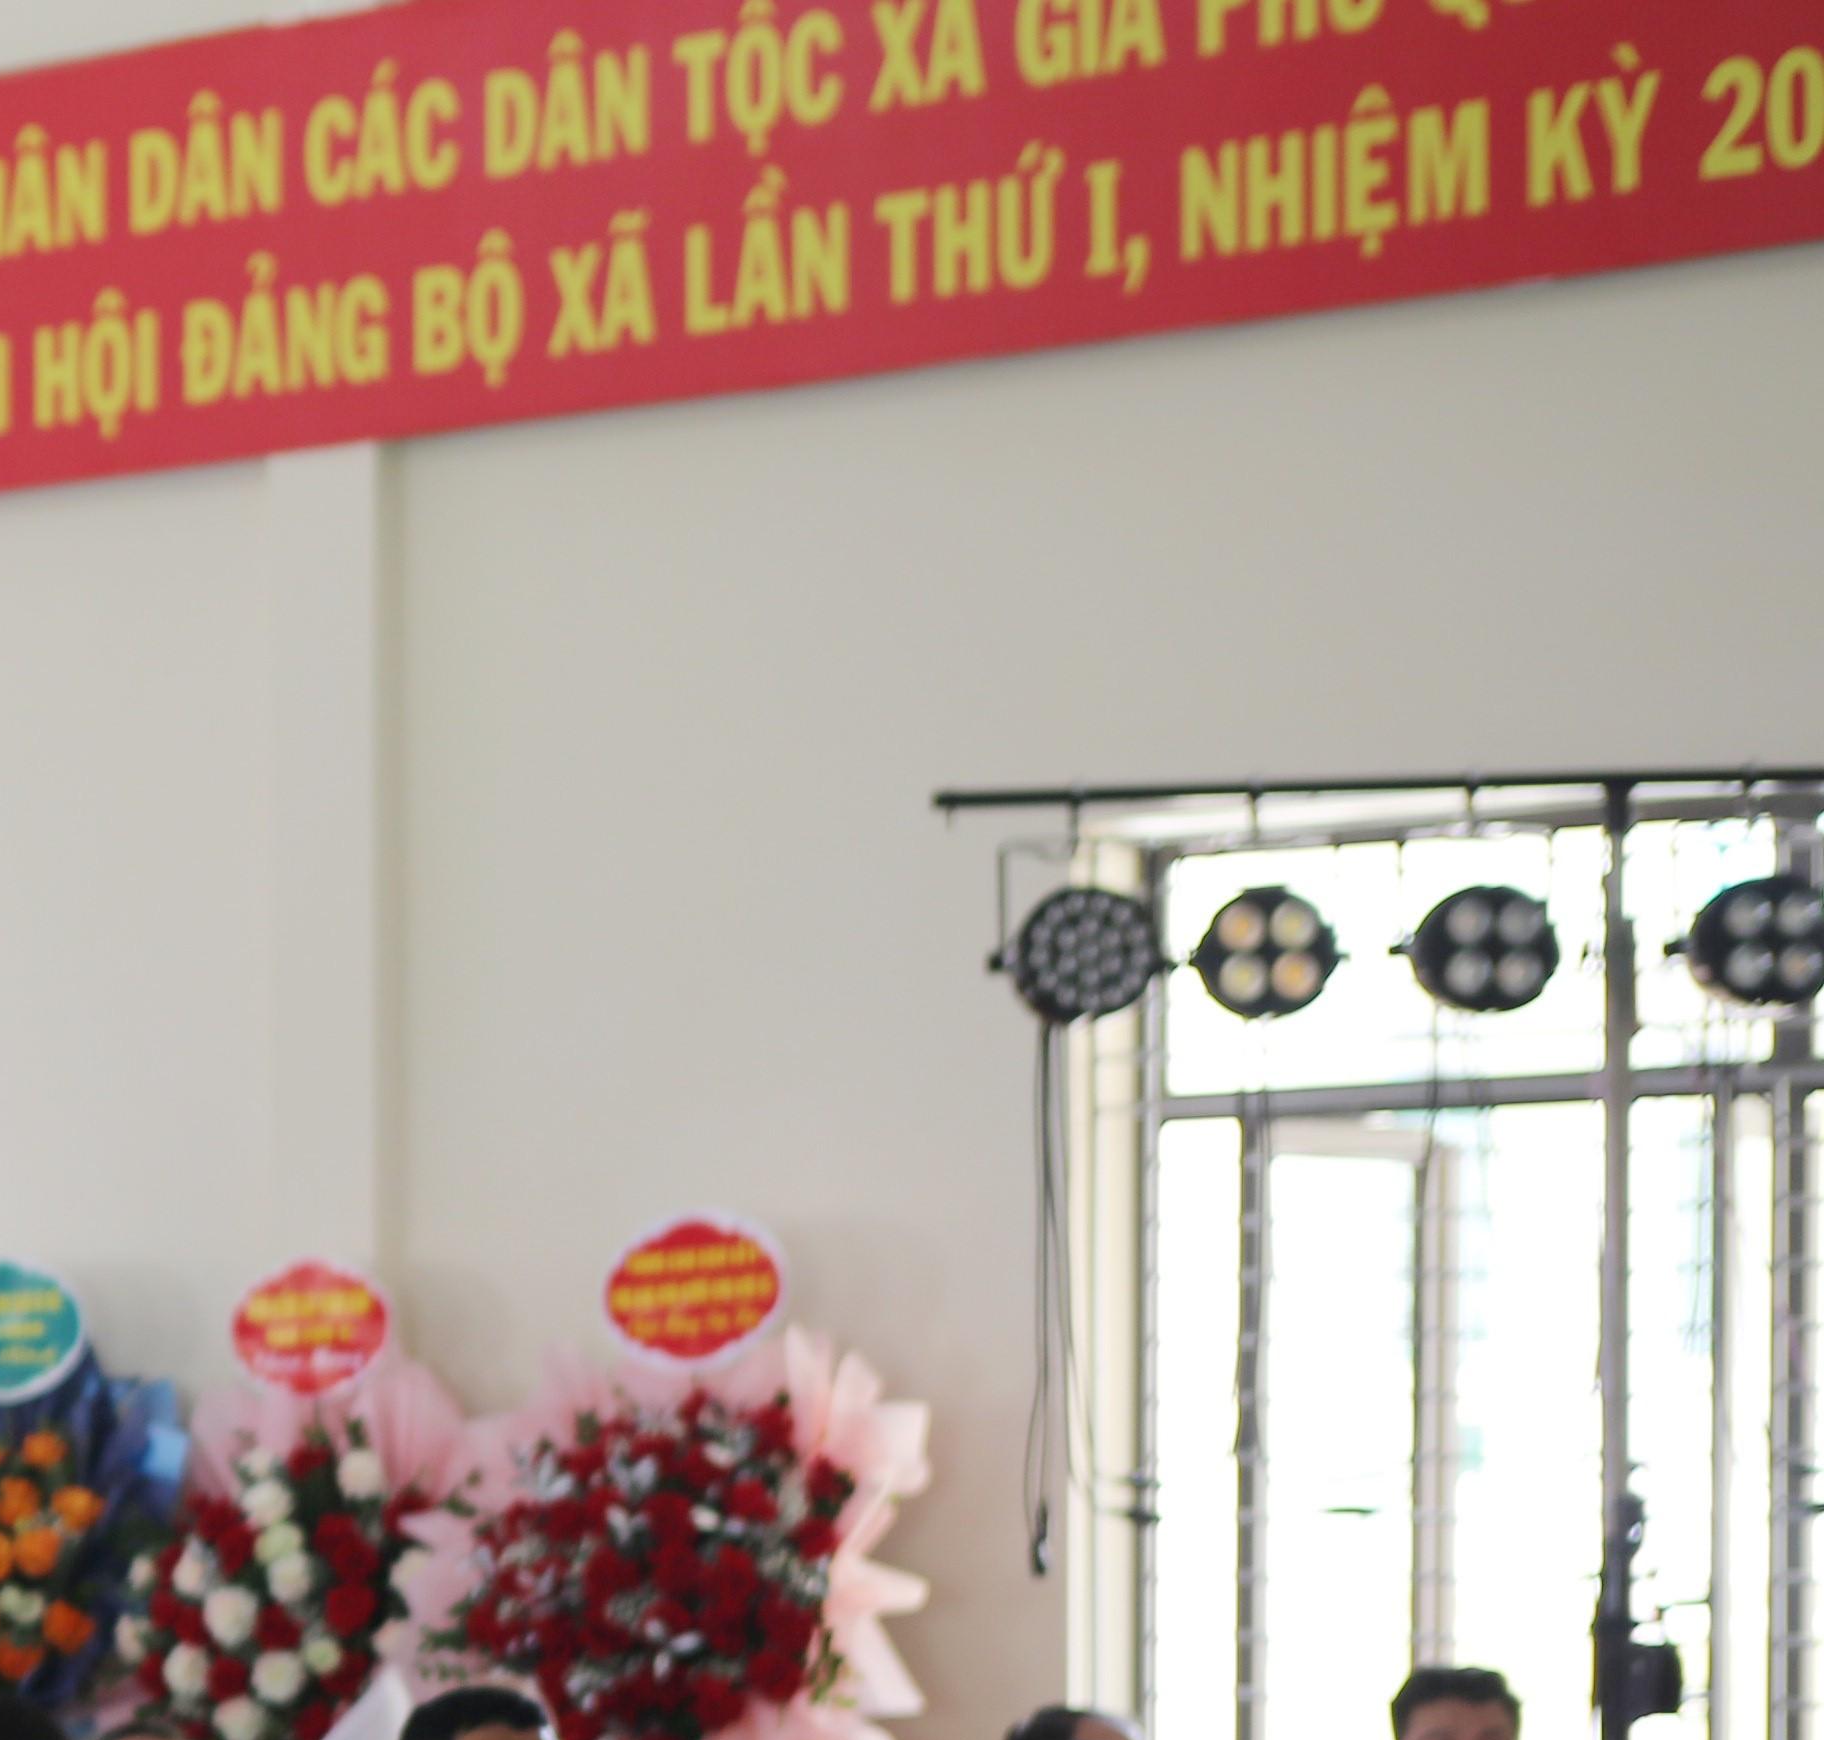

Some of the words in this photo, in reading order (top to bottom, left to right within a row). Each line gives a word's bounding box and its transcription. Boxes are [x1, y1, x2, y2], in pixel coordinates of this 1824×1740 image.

[34, 288, 159, 437] HỘI
[181, 252, 389, 405] ĐẢNG
[413, 229, 523, 386] BỘ
[549, 210, 655, 357] XÃ
[685, 166, 849, 335] LẦN
[875, 143, 1063, 303] THỨ
[1087, 161, 1148, 290] I,
[1181, 88, 1487, 258] NHIỆM
[1530, 44, 1657, 204] KỲ
[129, 91, 283, 234] DÂN
[304, 60, 459, 206] CÁC
[485, 30, 650, 179] DÂN
[672, 0, 843, 154] TỘC
